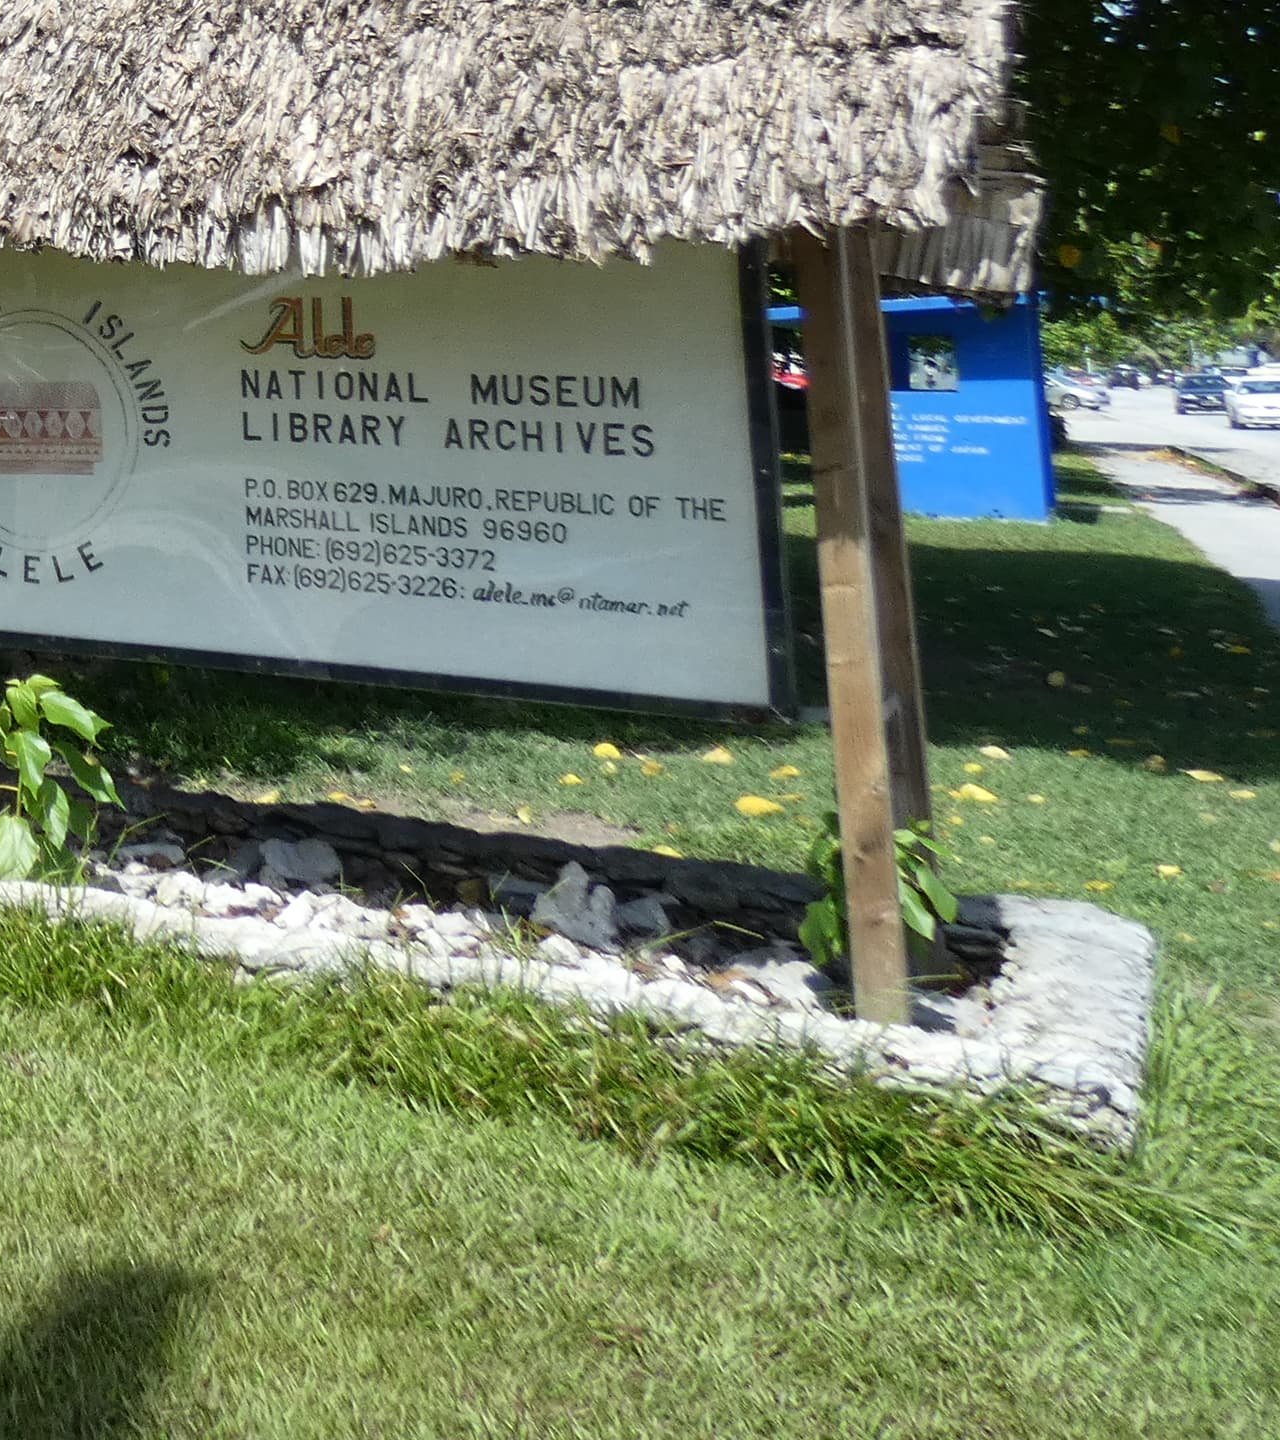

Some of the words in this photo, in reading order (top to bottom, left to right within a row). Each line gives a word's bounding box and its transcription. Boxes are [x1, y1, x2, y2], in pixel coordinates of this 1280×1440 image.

[238, 295, 377, 360] Alele
[82, 299, 171, 448] ISLANDS
[240, 369, 429, 404] NATIONAL
[470, 373, 641, 410] MUSEUM
[242, 411, 407, 448] LIBRARY
[444, 418, 656, 459] ARCHIVES
[244, 478, 283, 500] P.O.
[287, 479, 329, 503] BOX
[495, 488, 616, 517] REPUBLIC
[628, 495, 661, 518] OF
[675, 496, 727, 523] THE
[245, 505, 361, 533] MARSHALL
[369, 512, 469, 540] ISLANDS
[482, 518, 569, 545] 96960
